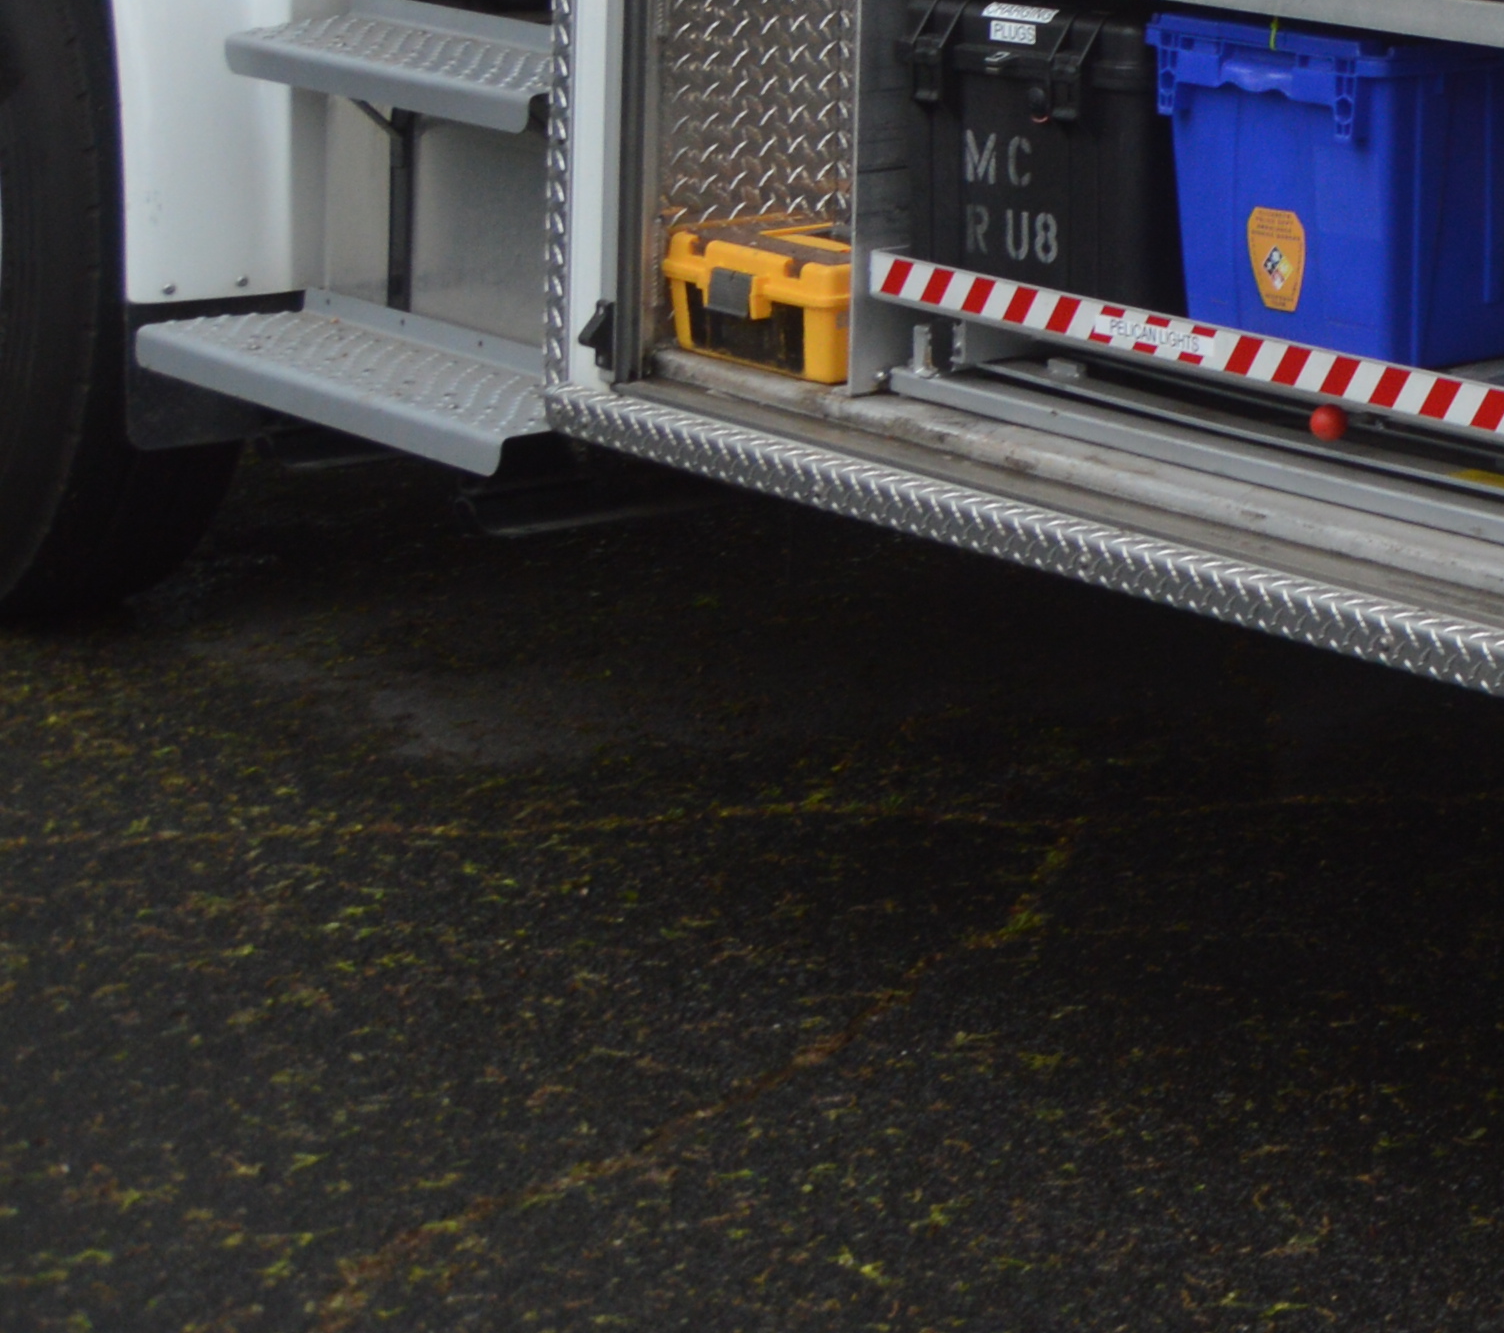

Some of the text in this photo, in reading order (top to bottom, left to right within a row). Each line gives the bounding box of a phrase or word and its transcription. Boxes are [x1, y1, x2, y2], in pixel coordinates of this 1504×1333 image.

[994, 23, 1035, 42] PLUGS
[1109, 318, 1200, 353] PELICAN LIGHTS
